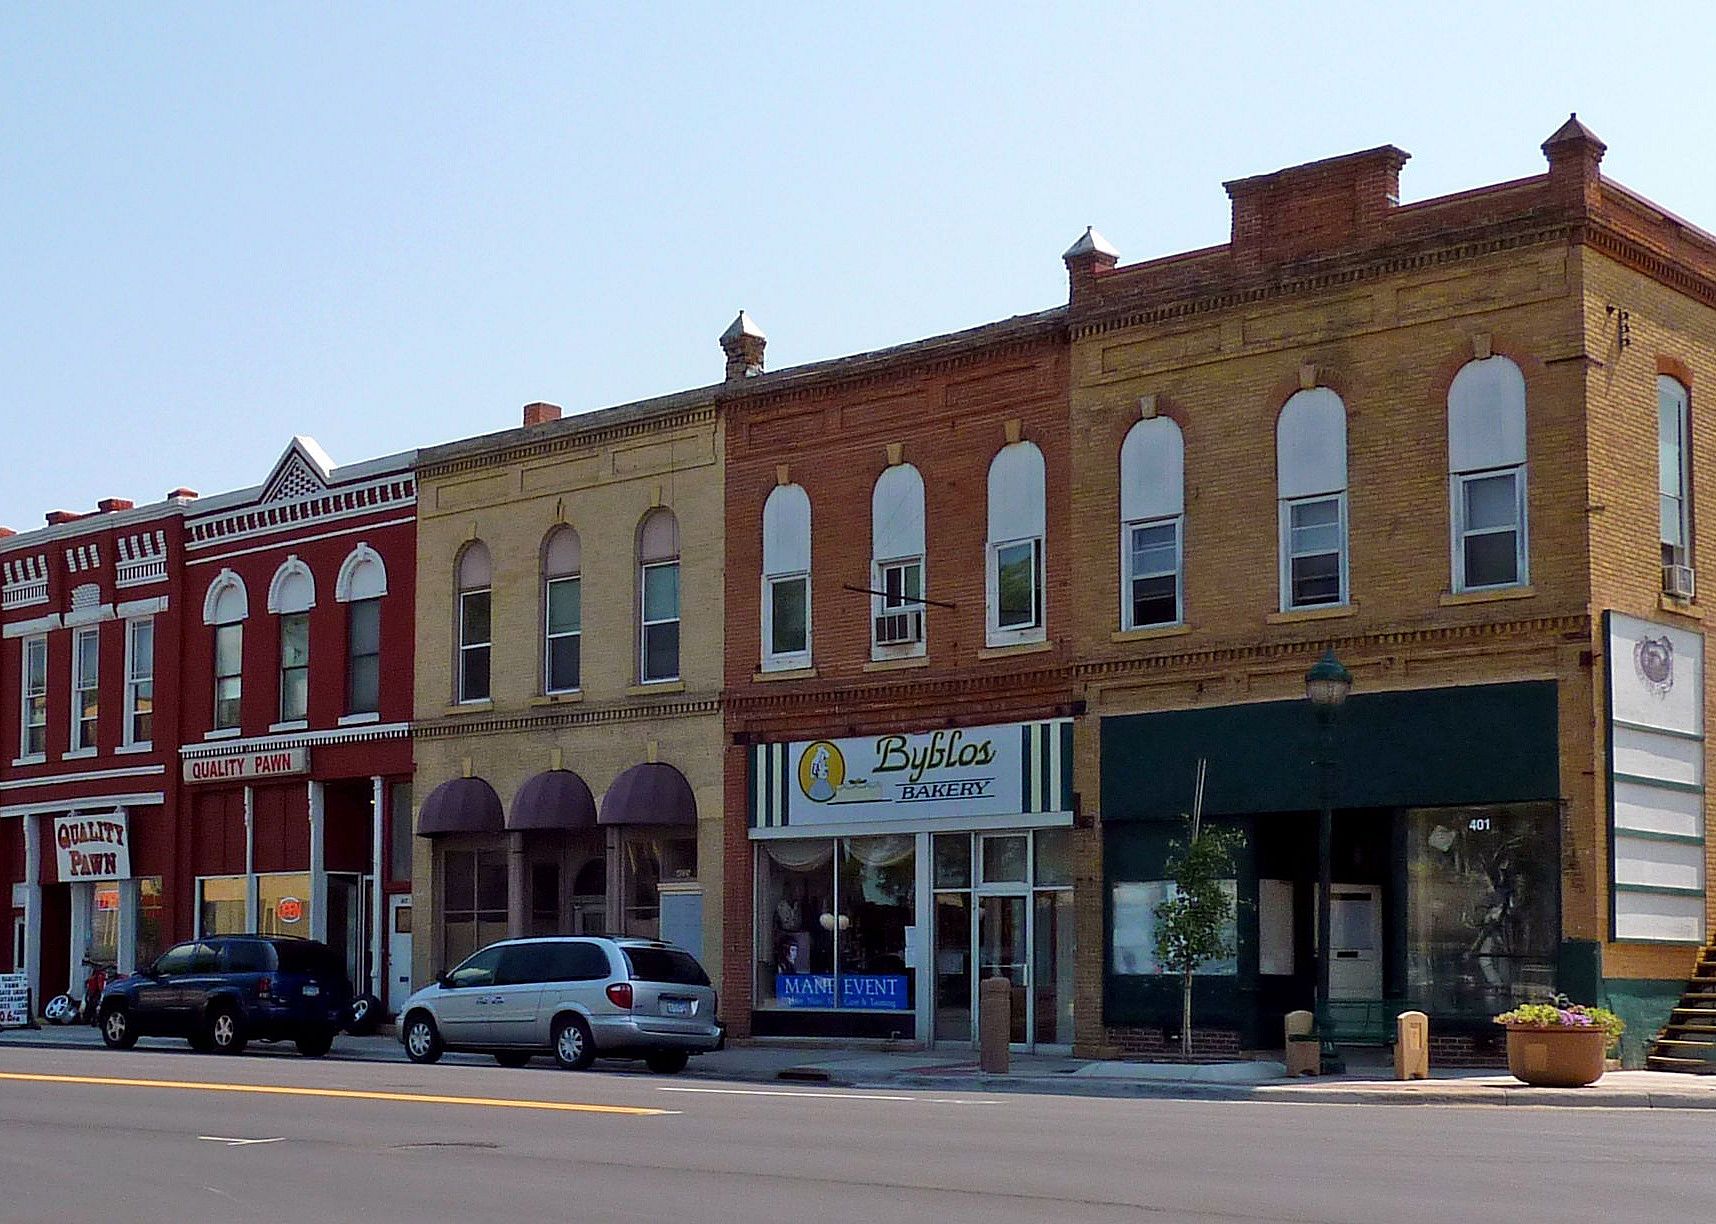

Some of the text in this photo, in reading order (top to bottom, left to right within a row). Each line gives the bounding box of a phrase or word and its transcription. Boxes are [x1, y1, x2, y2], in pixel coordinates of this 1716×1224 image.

[192, 753, 292, 779] QUALITY PAWN
[872, 730, 997, 782] Byblos
[901, 781, 991, 800] BAKERY
[58, 821, 124, 849] QUALITY
[1469, 818, 1490, 831] 401
[69, 850, 117, 876] PAWN
[844, 978, 898, 996] EVENT
